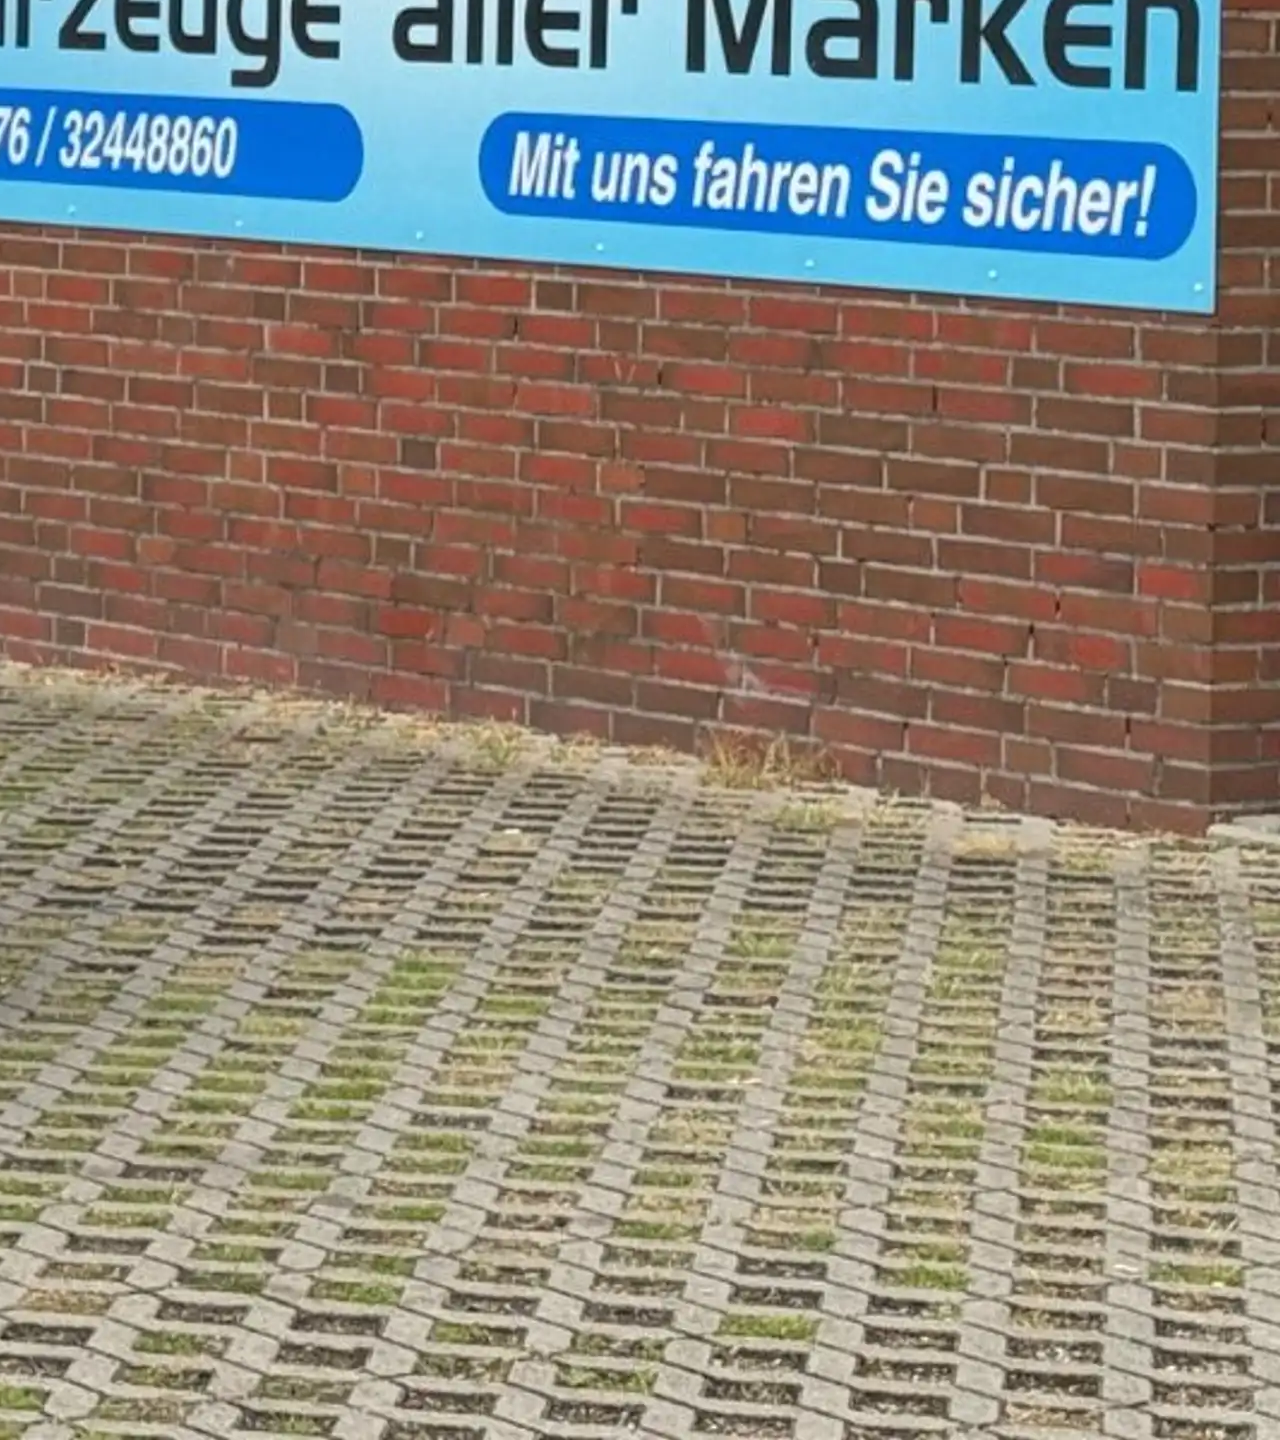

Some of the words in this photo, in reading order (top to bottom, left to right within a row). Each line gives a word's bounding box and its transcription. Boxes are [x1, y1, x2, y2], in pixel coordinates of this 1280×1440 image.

[60, 109, 237, 178] 32448860
[509, 131, 580, 201] Mit
[592, 148, 676, 206] uns
[693, 143, 847, 218] fahren
[865, 150, 947, 223] Sie
[963, 156, 1156, 238] sicher!
